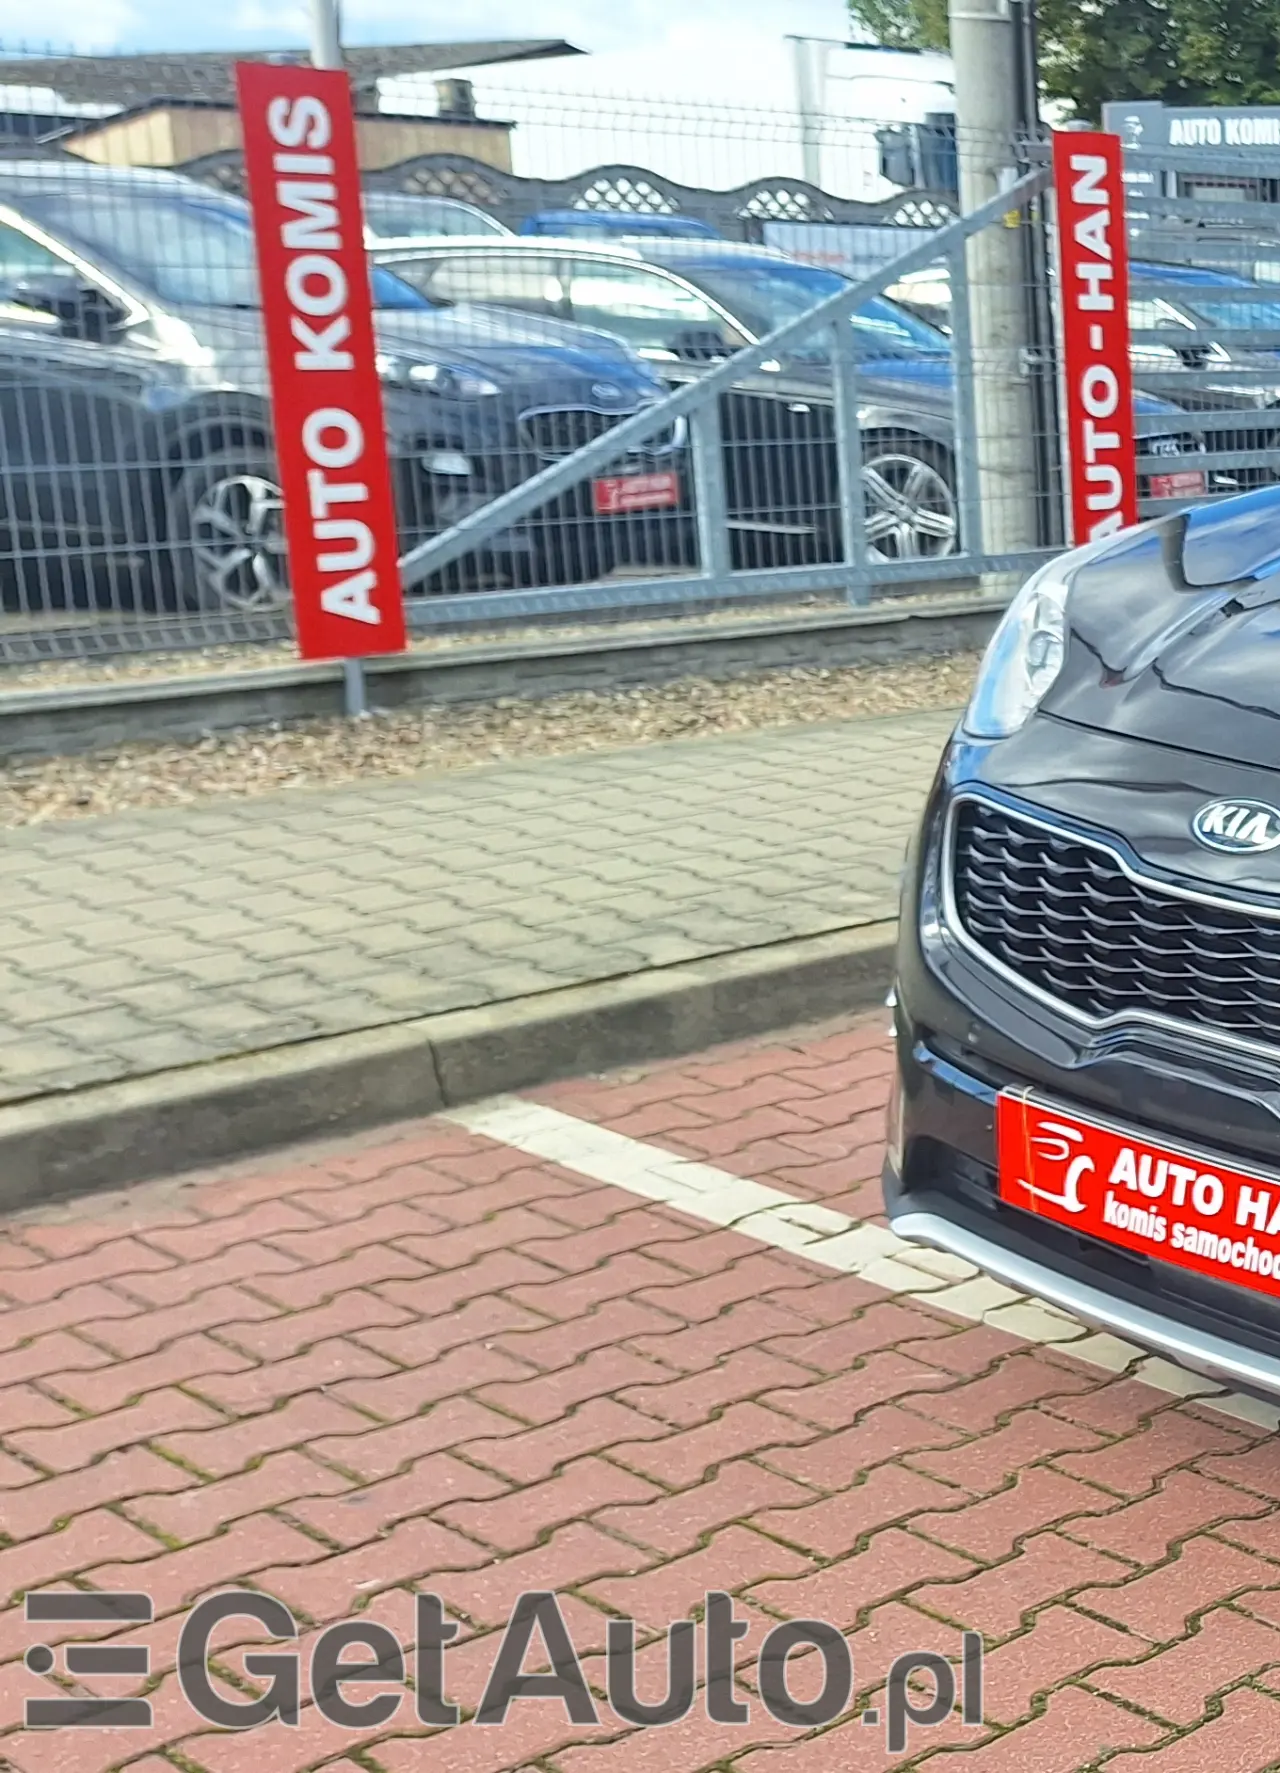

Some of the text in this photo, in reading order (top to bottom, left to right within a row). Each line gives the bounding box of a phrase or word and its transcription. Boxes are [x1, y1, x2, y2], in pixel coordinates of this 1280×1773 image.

[1169, 116, 1221, 146] AUTO
[268, 95, 381, 627] AUTO KOMIS
[1200, 803, 1275, 845] KIA
[1107, 1147, 1225, 1216] AUTO
[1103, 1190, 1168, 1242] komis
